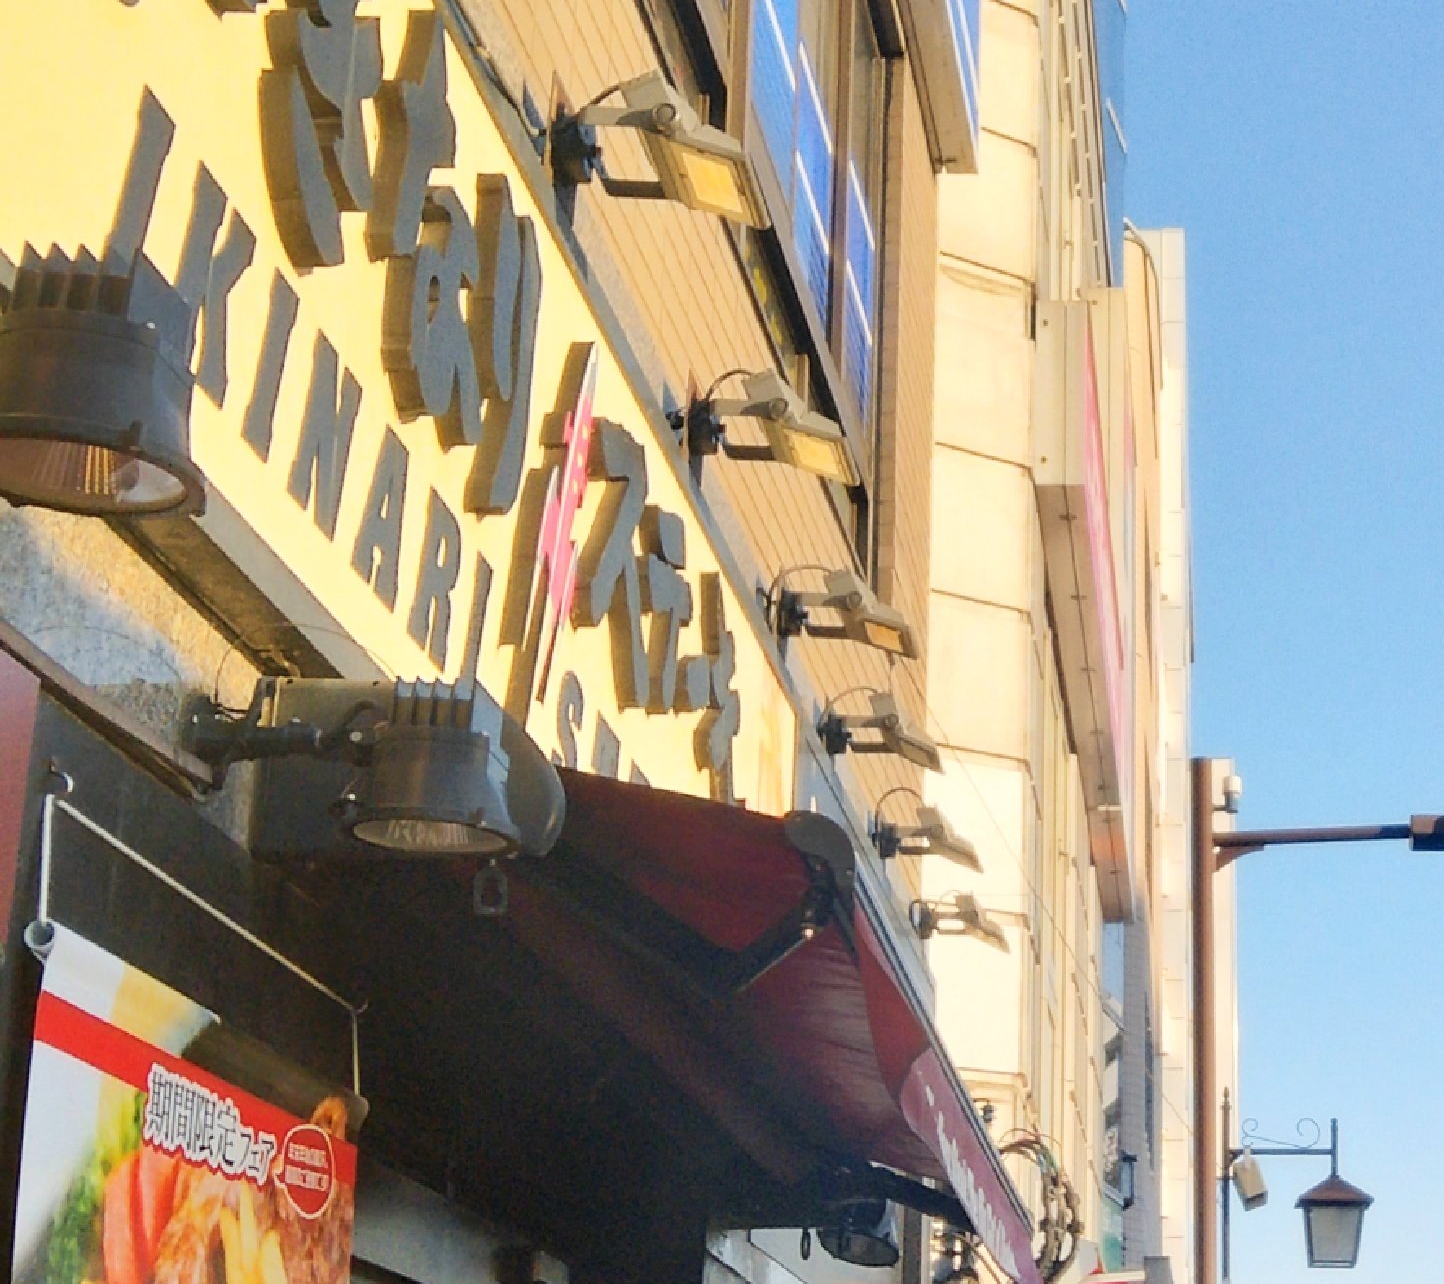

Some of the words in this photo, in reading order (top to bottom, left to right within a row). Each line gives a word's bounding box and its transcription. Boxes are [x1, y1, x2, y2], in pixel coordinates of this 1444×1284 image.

[147, 1066, 275, 1176] 期間限定フェア
